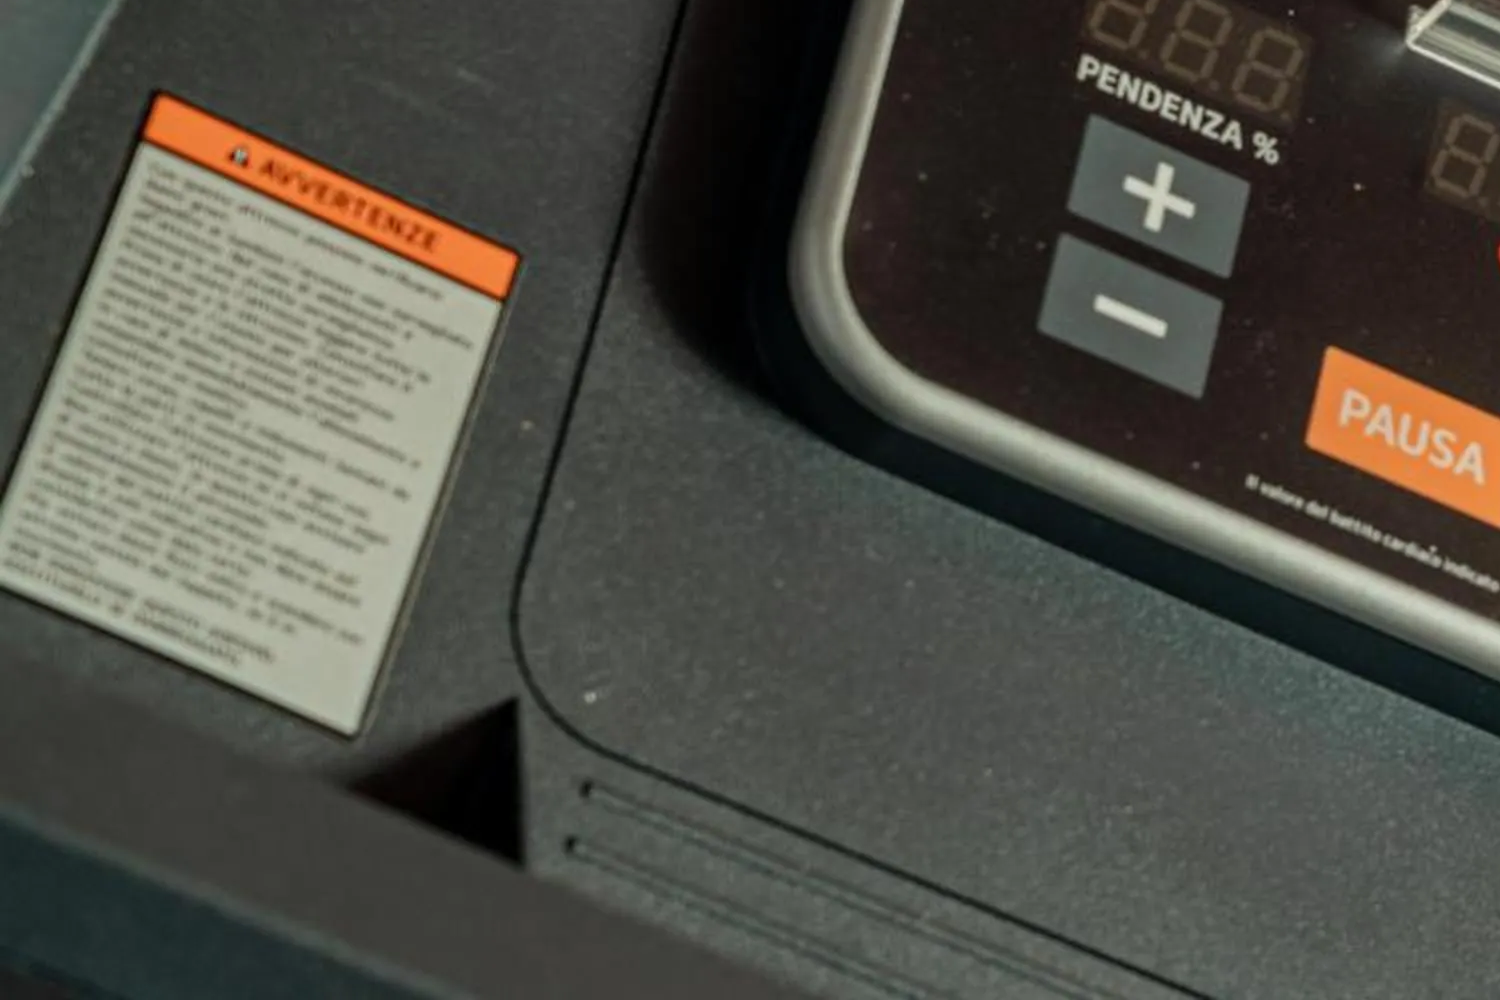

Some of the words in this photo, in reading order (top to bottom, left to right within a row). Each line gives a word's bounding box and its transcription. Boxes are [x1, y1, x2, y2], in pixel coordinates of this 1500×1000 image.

[1077, 54, 1243, 149] PENDENZA
[1253, 131, 1279, 165] %
[1339, 389, 1486, 487] PAUSA
